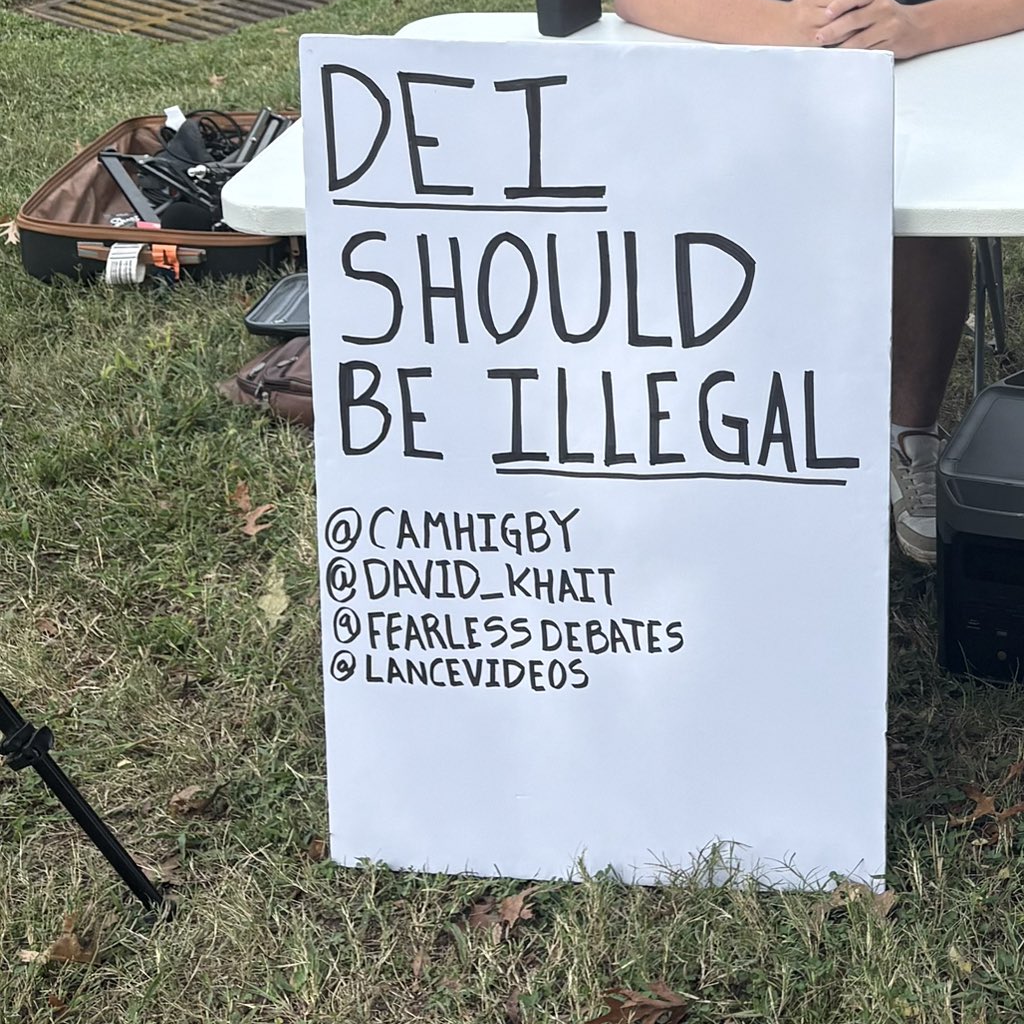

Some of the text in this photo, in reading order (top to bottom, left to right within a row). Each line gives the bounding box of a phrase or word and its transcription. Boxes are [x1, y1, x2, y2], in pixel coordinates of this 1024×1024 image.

[320, 62, 607, 200] DEI
[340, 230, 757, 349] SHOULD
[339, 360, 860, 473] BE ILLEGAL
[324, 506, 581, 556] @CAMHIGBY
[326, 556, 616, 606] @DAVID_KHAIT
[330, 649, 590, 692] @LANCEVIDEOS
